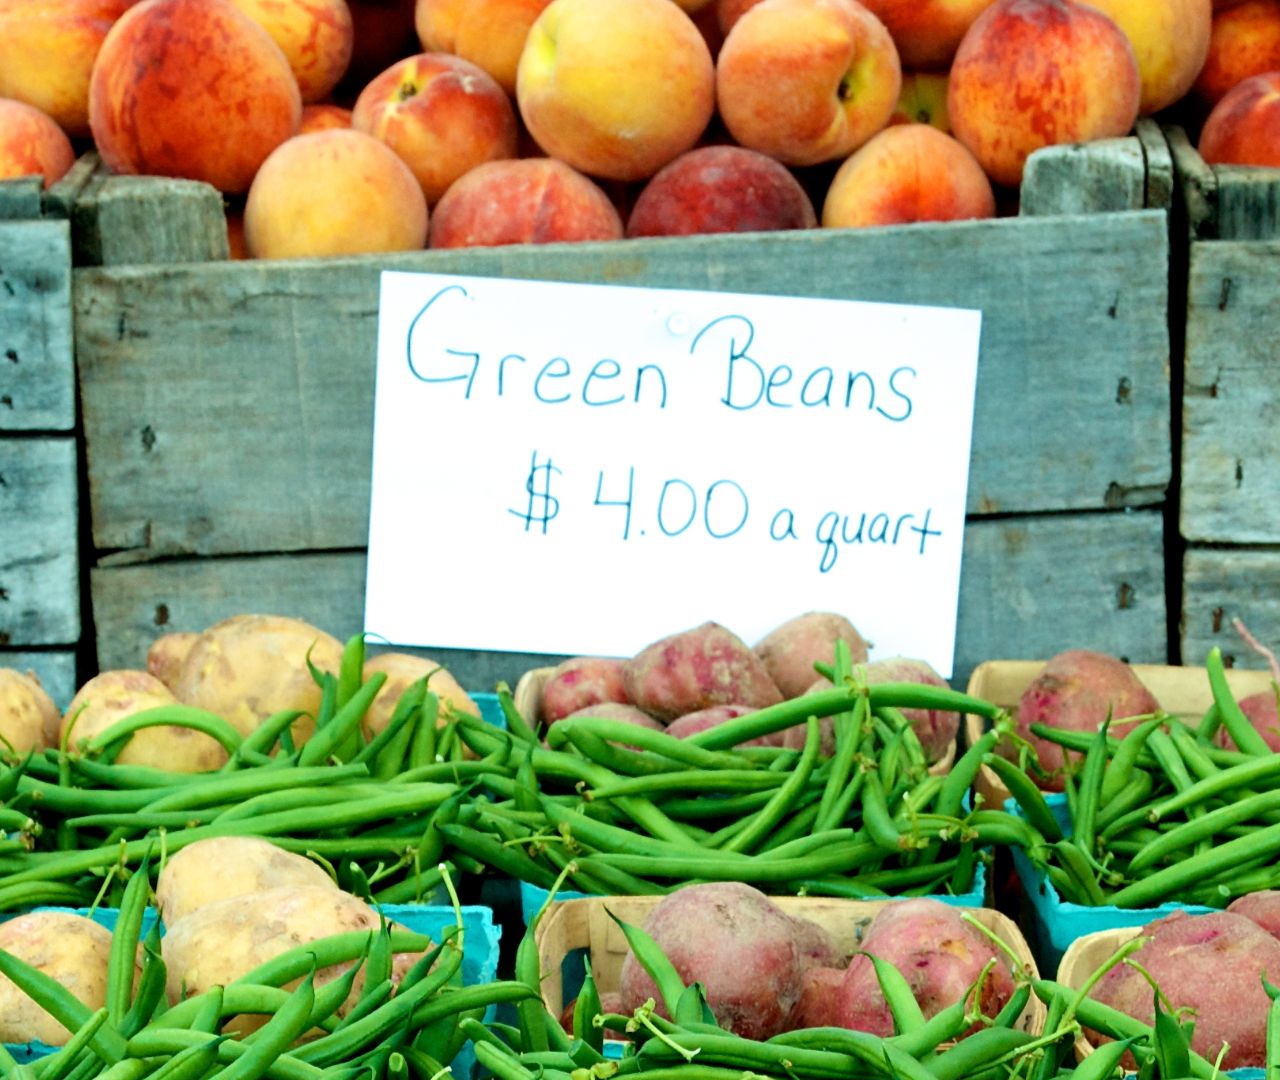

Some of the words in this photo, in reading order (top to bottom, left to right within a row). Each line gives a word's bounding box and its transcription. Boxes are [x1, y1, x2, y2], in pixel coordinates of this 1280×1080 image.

[406, 285, 668, 409] Green
[690, 314, 917, 422] Beans
[770, 508, 798, 541] a
[816, 508, 942, 573] quart
